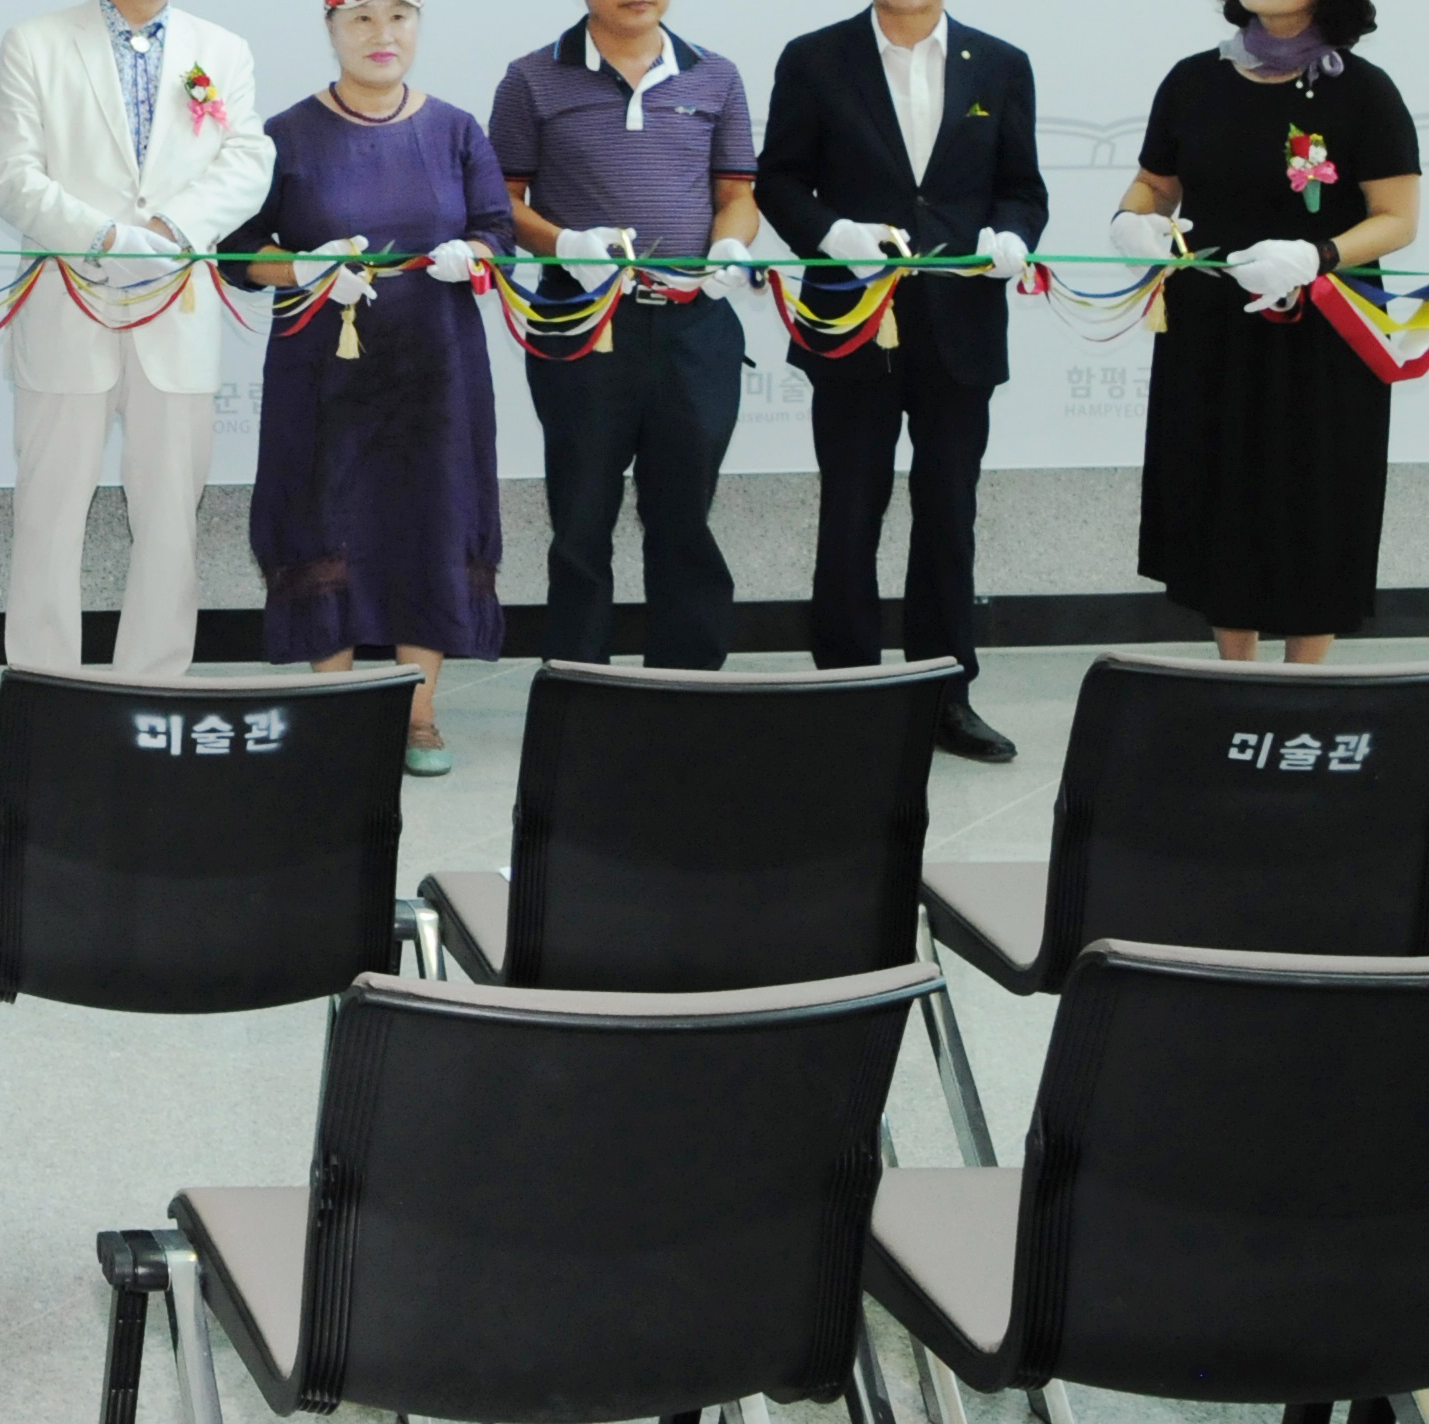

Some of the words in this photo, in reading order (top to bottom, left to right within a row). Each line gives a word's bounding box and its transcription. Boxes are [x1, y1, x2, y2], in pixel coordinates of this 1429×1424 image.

[1064, 403, 1145, 418] HAMPYEO
[135, 708, 286, 756] 미술관
[1228, 732, 1370, 770] 미술관
